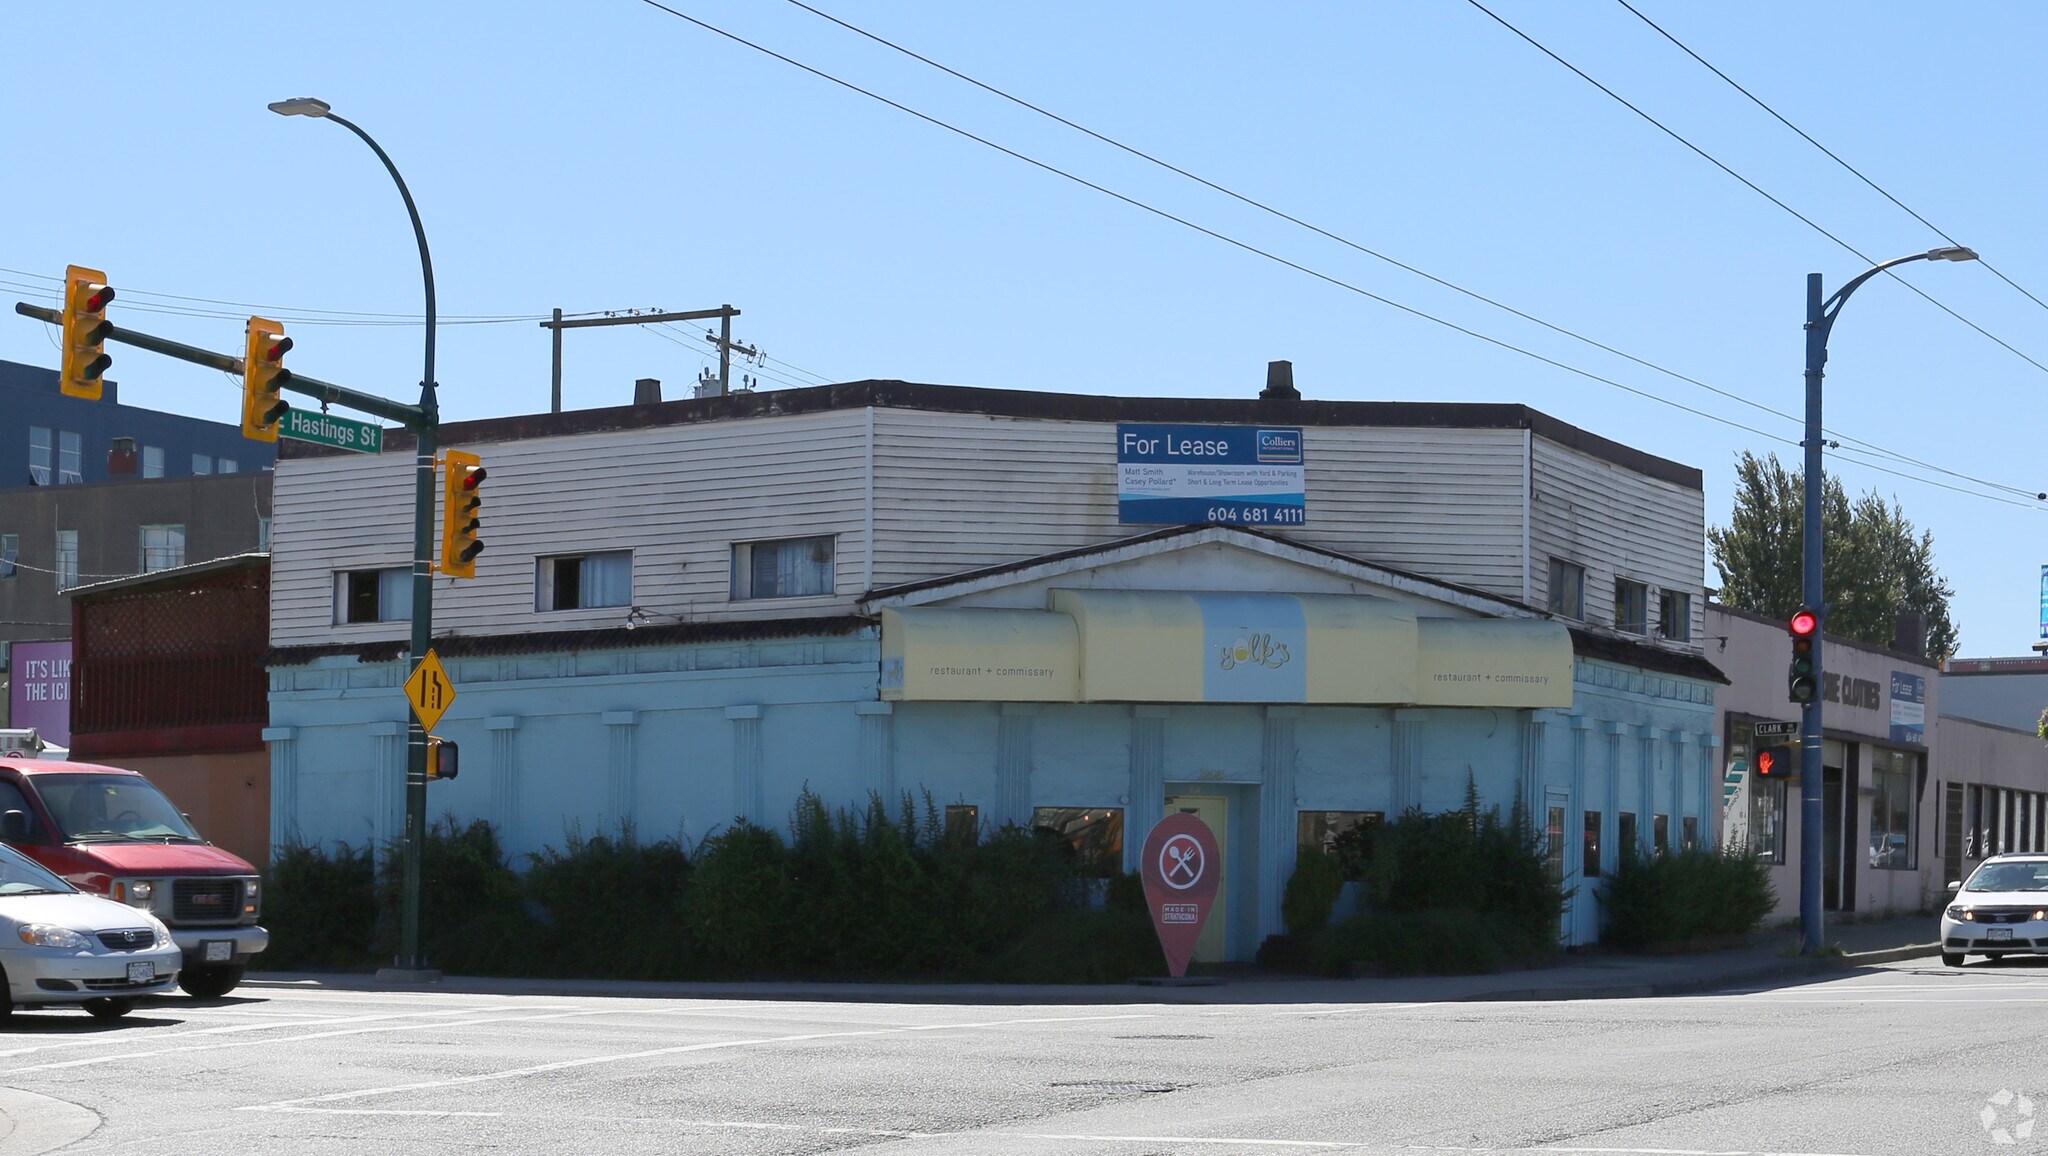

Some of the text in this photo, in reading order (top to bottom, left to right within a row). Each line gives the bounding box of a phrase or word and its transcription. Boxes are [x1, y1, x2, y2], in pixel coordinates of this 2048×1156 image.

[291, 411, 355, 445] Hastings
[360, 426, 376, 447] St
[1124, 433, 1229, 456] For Lease
[1261, 435, 1296, 447] Colliers
[1124, 467, 1164, 476] Matt Smith
[1246, 469, 1258, 477] with
[1259, 469, 1271, 477] Yard
[1277, 470, 1297, 479] Parking
[1124, 477, 1147, 487] Casey
[1187, 478, 1202, 486] Short
[1203, 478, 1208, 486] &
[1208, 478, 1222, 487] Long
[1254, 479, 1289, 488] Opportunities
[1207, 507, 1303, 522] 604 681 4111
[25, 660, 48, 679] IT'S
[930, 666, 981, 676] restaurant
[996, 667, 1054, 678] commissary
[1433, 672, 1481, 682] restaurant
[1494, 673, 1549, 685] commissary
[25, 682, 71, 701] THE ICI
[1758, 724, 1782, 734] CLARK
